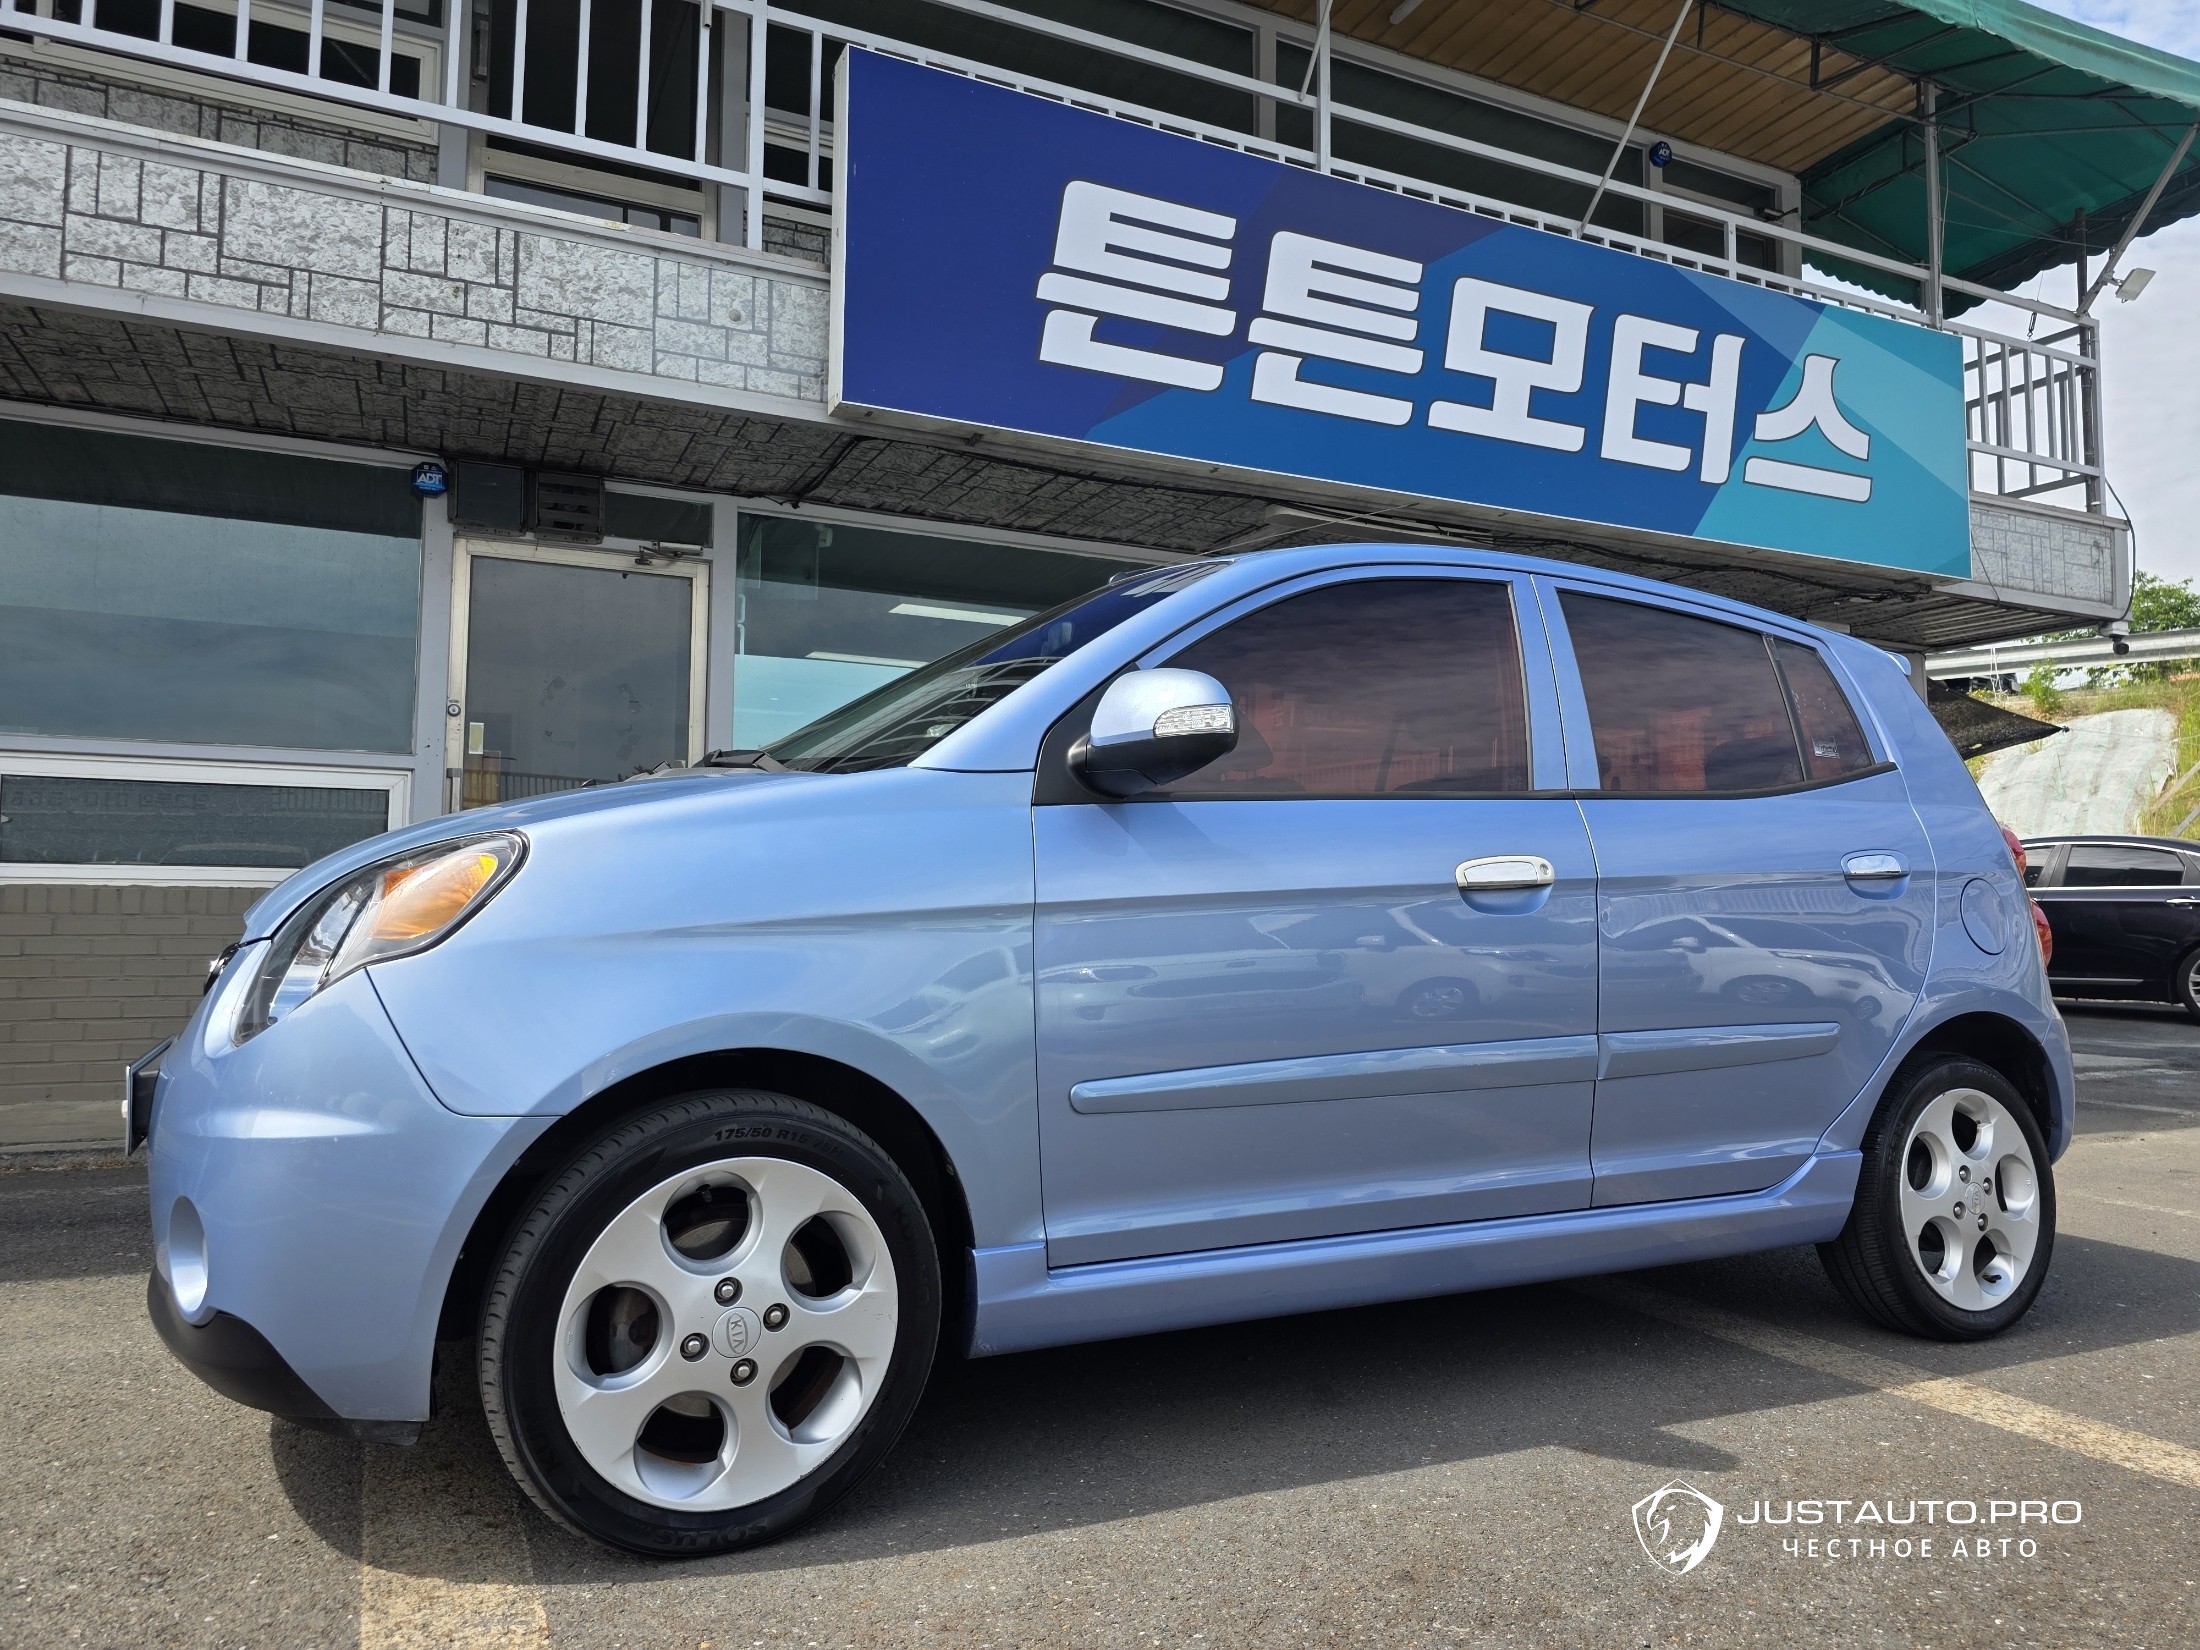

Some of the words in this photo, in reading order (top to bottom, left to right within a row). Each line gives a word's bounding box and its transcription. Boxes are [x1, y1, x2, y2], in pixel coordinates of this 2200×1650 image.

[1037, 181, 1872, 502] 튼튼모터스
[416, 472, 443, 485] ADT
[715, 1127, 773, 1141] 175/50
[776, 1129, 809, 1144] R15
[730, 1318, 744, 1349] KIA
